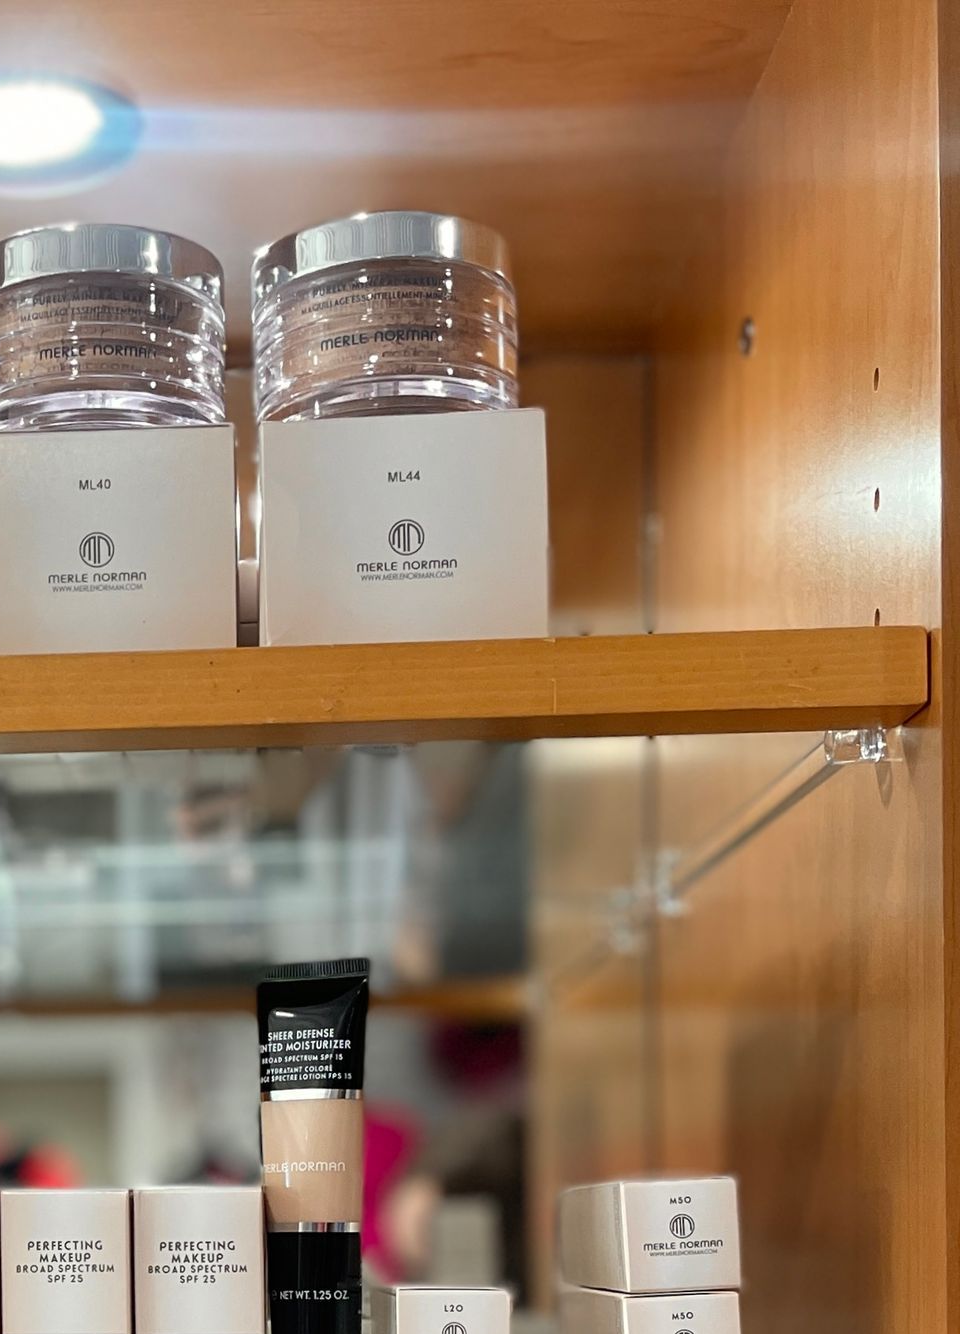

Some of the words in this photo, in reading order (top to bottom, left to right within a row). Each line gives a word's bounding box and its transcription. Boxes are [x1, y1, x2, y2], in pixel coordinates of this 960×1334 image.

[320, 334, 368, 351] MERLE
[374, 329, 439, 342] NORMAN
[93, 344, 156, 358] NORMAN
[388, 470, 420, 482] ML44
[79, 478, 111, 490] ML40
[357, 561, 397, 573] MERLE
[402, 558, 457, 571] NORMAN
[48, 572, 88, 584] MERLE
[92, 570, 146, 582] NORMAN
[268, 1031, 293, 1041] SHEER
[296, 1028, 334, 1040] DEFENSE
[286, 1040, 351, 1051] MOISTURIZER
[284, 1054, 318, 1062] SPECTRUM
[266, 1066, 302, 1075] HYDRATANT
[271, 1074, 297, 1082] SPECTRE
[291, 1162, 345, 1172] NORMAN
[669, 1196, 692, 1204] M50
[280, 1291, 293, 1300] NET
[313, 1290, 331, 1300] 1.25
[444, 1304, 463, 1312] L20
[672, 1311, 694, 1320] M50
